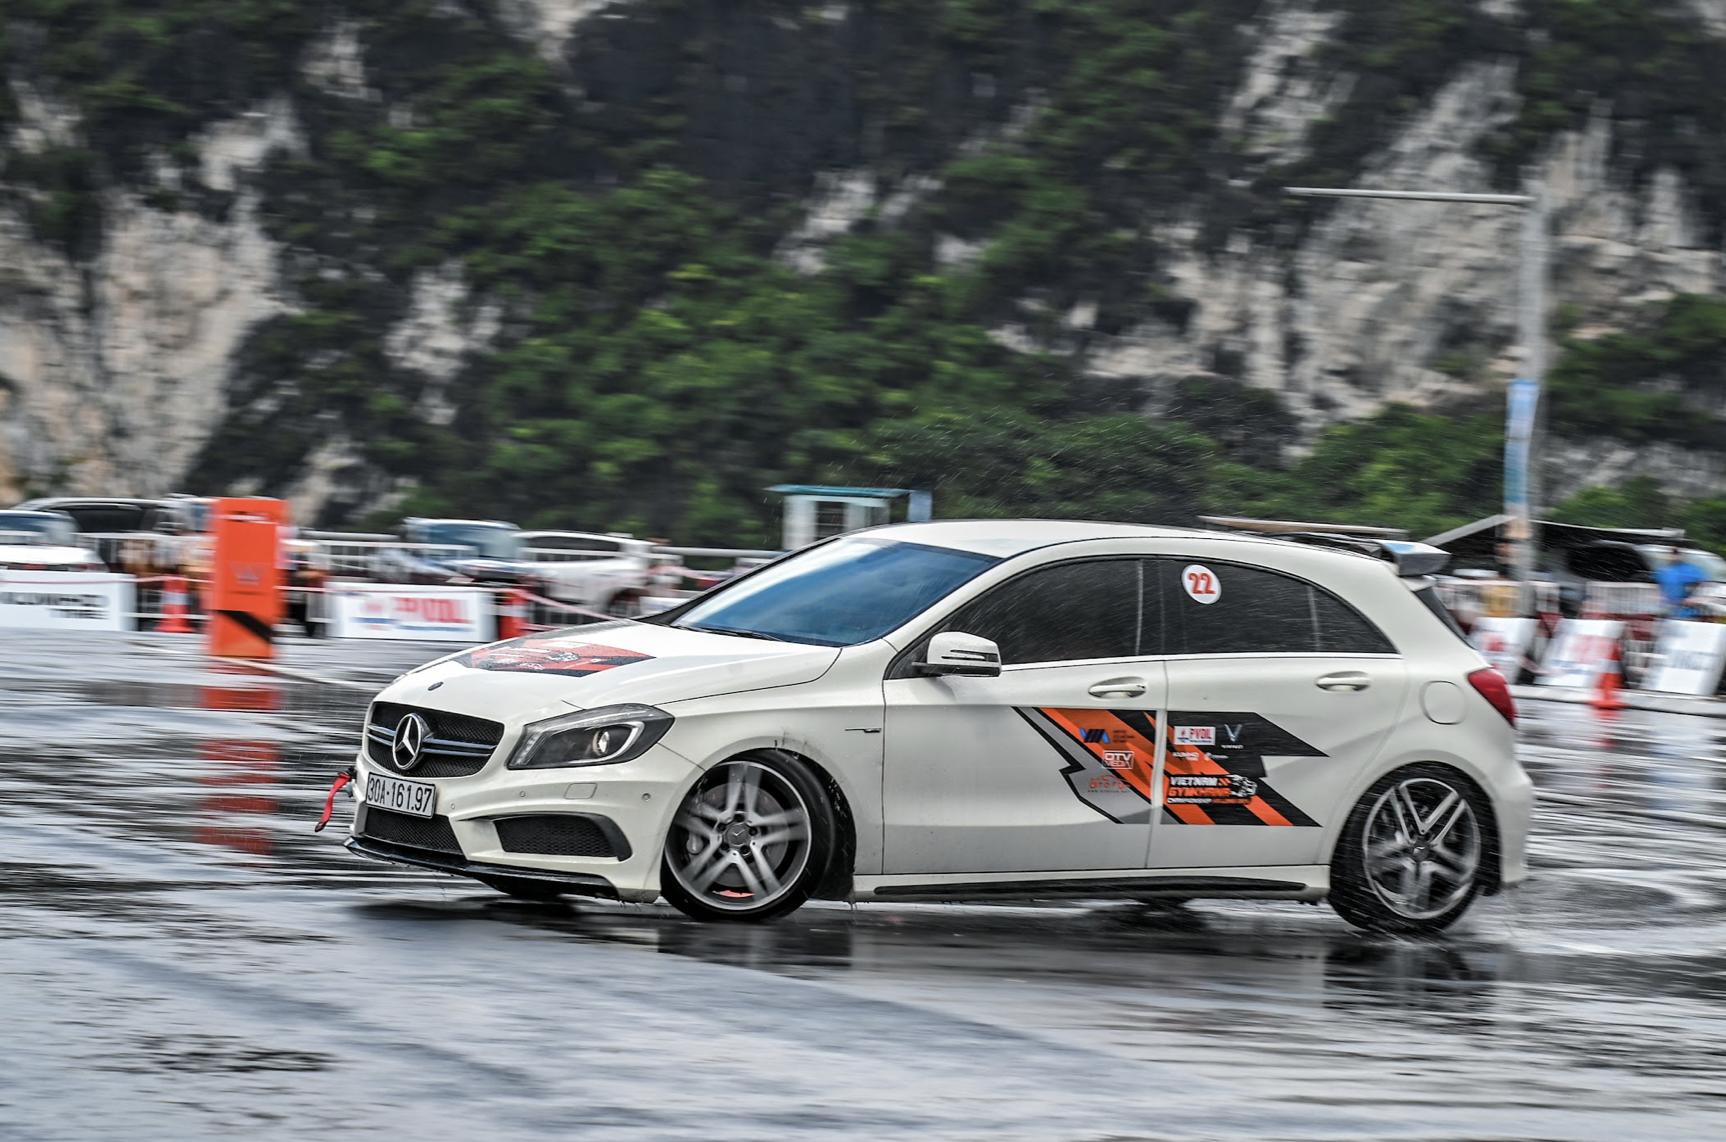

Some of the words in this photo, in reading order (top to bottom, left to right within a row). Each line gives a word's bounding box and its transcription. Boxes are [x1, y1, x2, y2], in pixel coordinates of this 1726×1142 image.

[1187, 572, 1216, 595] 22
[1189, 728, 1213, 740] PVOIL
[1170, 776, 1218, 786] VIETNAM
